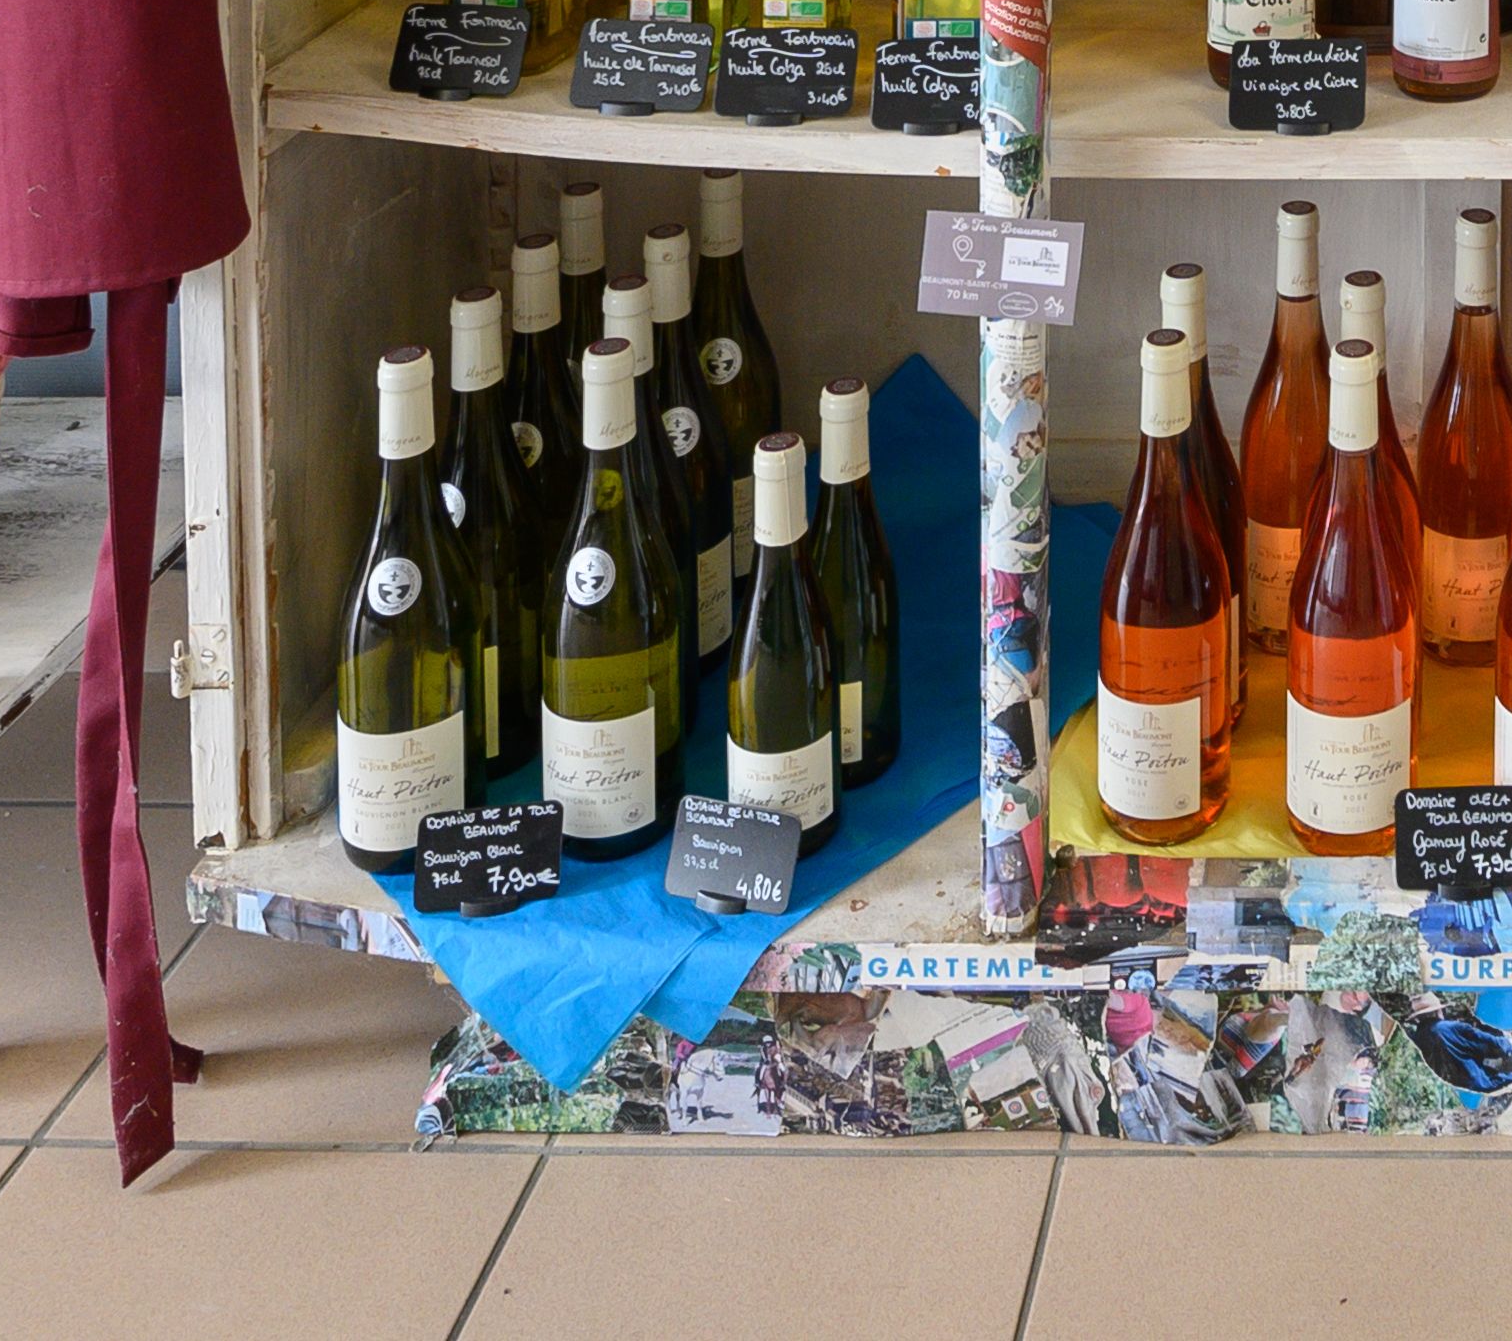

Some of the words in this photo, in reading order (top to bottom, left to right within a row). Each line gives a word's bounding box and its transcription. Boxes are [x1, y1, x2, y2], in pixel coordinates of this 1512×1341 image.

[952, 218, 969, 232] La
[972, 219, 997, 233] Tour
[1001, 222, 1059, 238] Beaumont
[922, 276, 1008, 290] BEAUMONT-SAINT-CYR
[947, 289, 960, 299] 70
[962, 290, 979, 301] km
[1426, 812, 1460, 826] TOUR
[1413, 829, 1466, 863] Gamay
[1471, 829, 1508, 848] Rosé
[735, 876, 782, 903] 4,80€
[868, 957, 1053, 978] GARTEMPE
